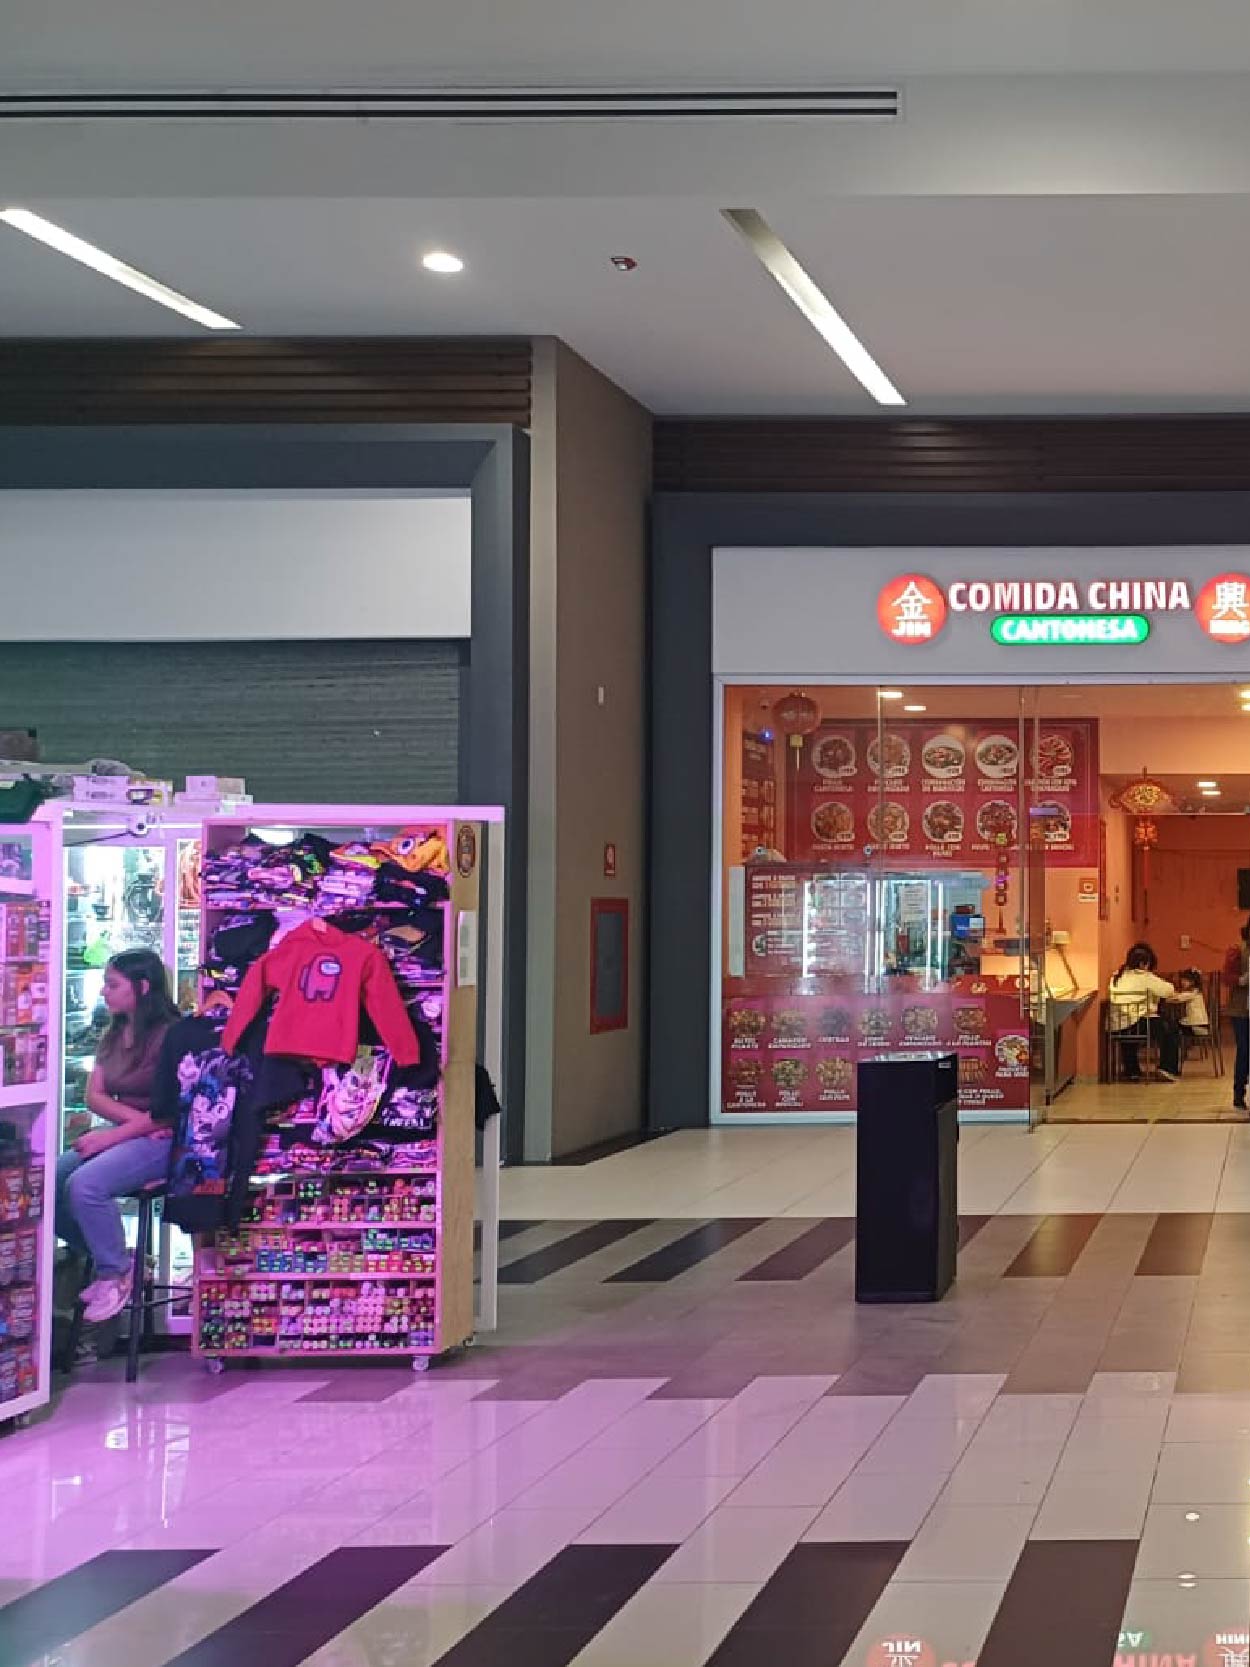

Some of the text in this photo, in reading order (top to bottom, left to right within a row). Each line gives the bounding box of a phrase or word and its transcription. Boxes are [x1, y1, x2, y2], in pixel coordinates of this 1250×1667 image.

[891, 581, 933, 620] 金
[948, 582, 1191, 611] COMIDA CHINA
[891, 621, 932, 637] JIN
[1001, 619, 1139, 641] CANTONESA
